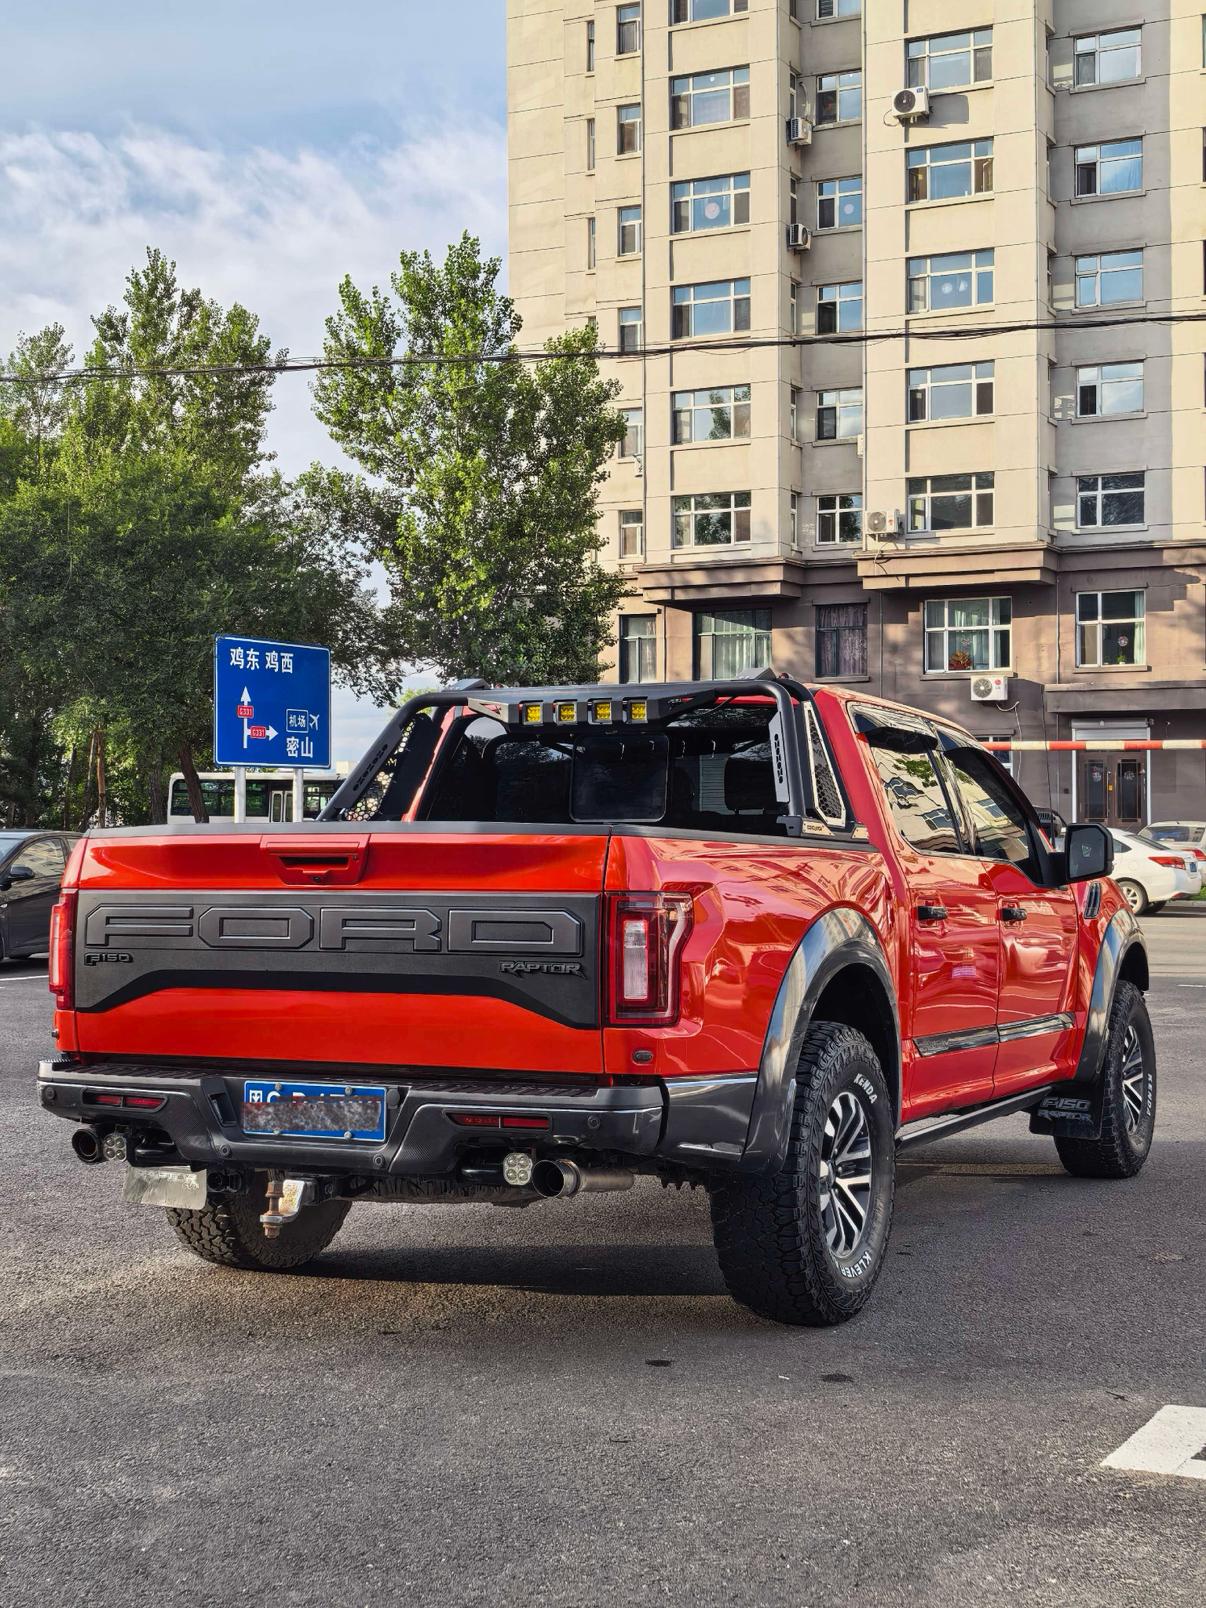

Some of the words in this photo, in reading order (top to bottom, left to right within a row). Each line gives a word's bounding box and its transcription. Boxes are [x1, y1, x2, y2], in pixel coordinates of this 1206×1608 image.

[230, 647, 260, 670] 鸡东
[265, 650, 294, 674] 鸡西
[289, 715, 306, 728] 机场
[286, 736, 314, 758] 密山
[85, 906, 584, 958] FORD
[84, 952, 133, 966] F150
[500, 961, 587, 980] RAPTOR
[854, 1073, 877, 1104] KENDA
[840, 1251, 871, 1278] KLEVER
